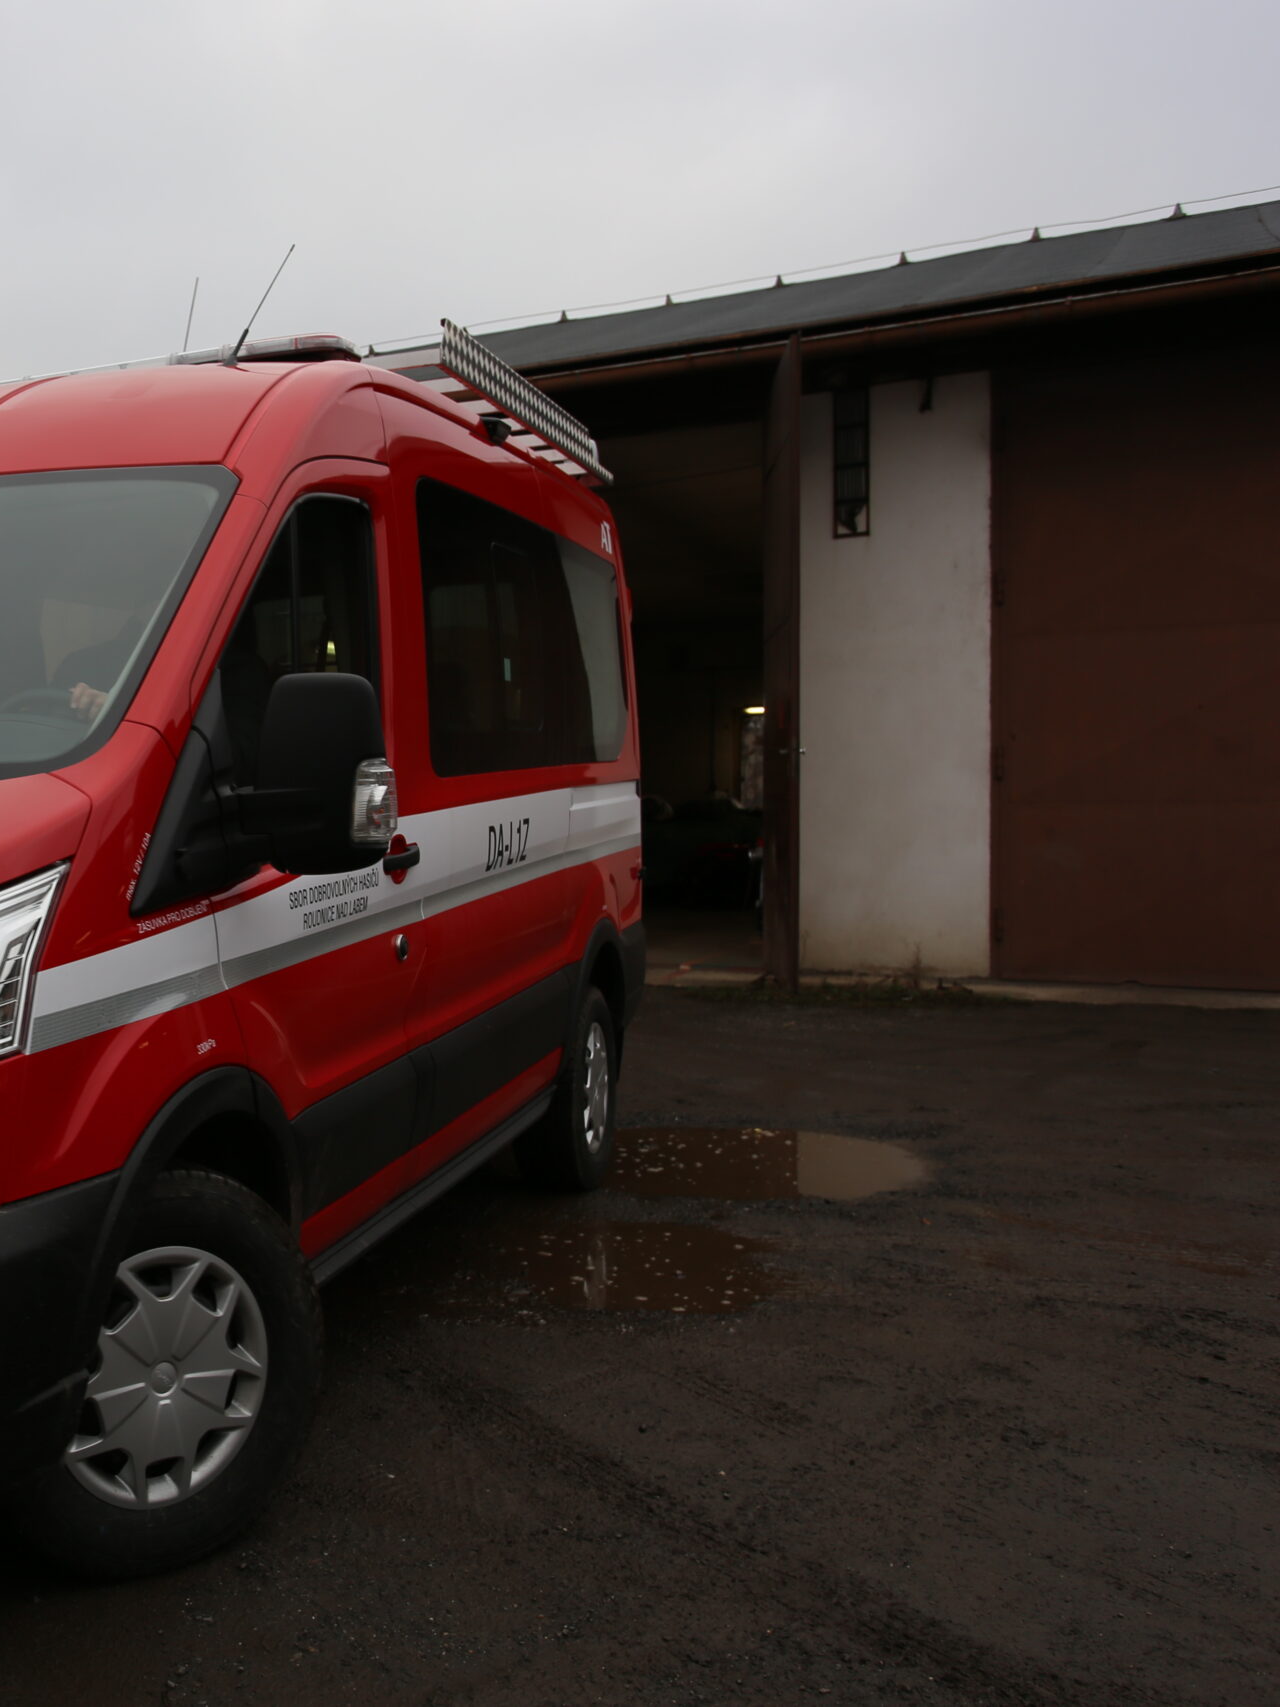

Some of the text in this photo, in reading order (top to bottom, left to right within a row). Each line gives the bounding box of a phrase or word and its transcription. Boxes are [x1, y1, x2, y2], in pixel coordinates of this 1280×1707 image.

[289, 867, 379, 910] SBOR DOBROVOLNÝCH HASIČŮ
[167, 911, 181, 923] PRO
[303, 895, 369, 931] ROUDNICE NAD LABEM
